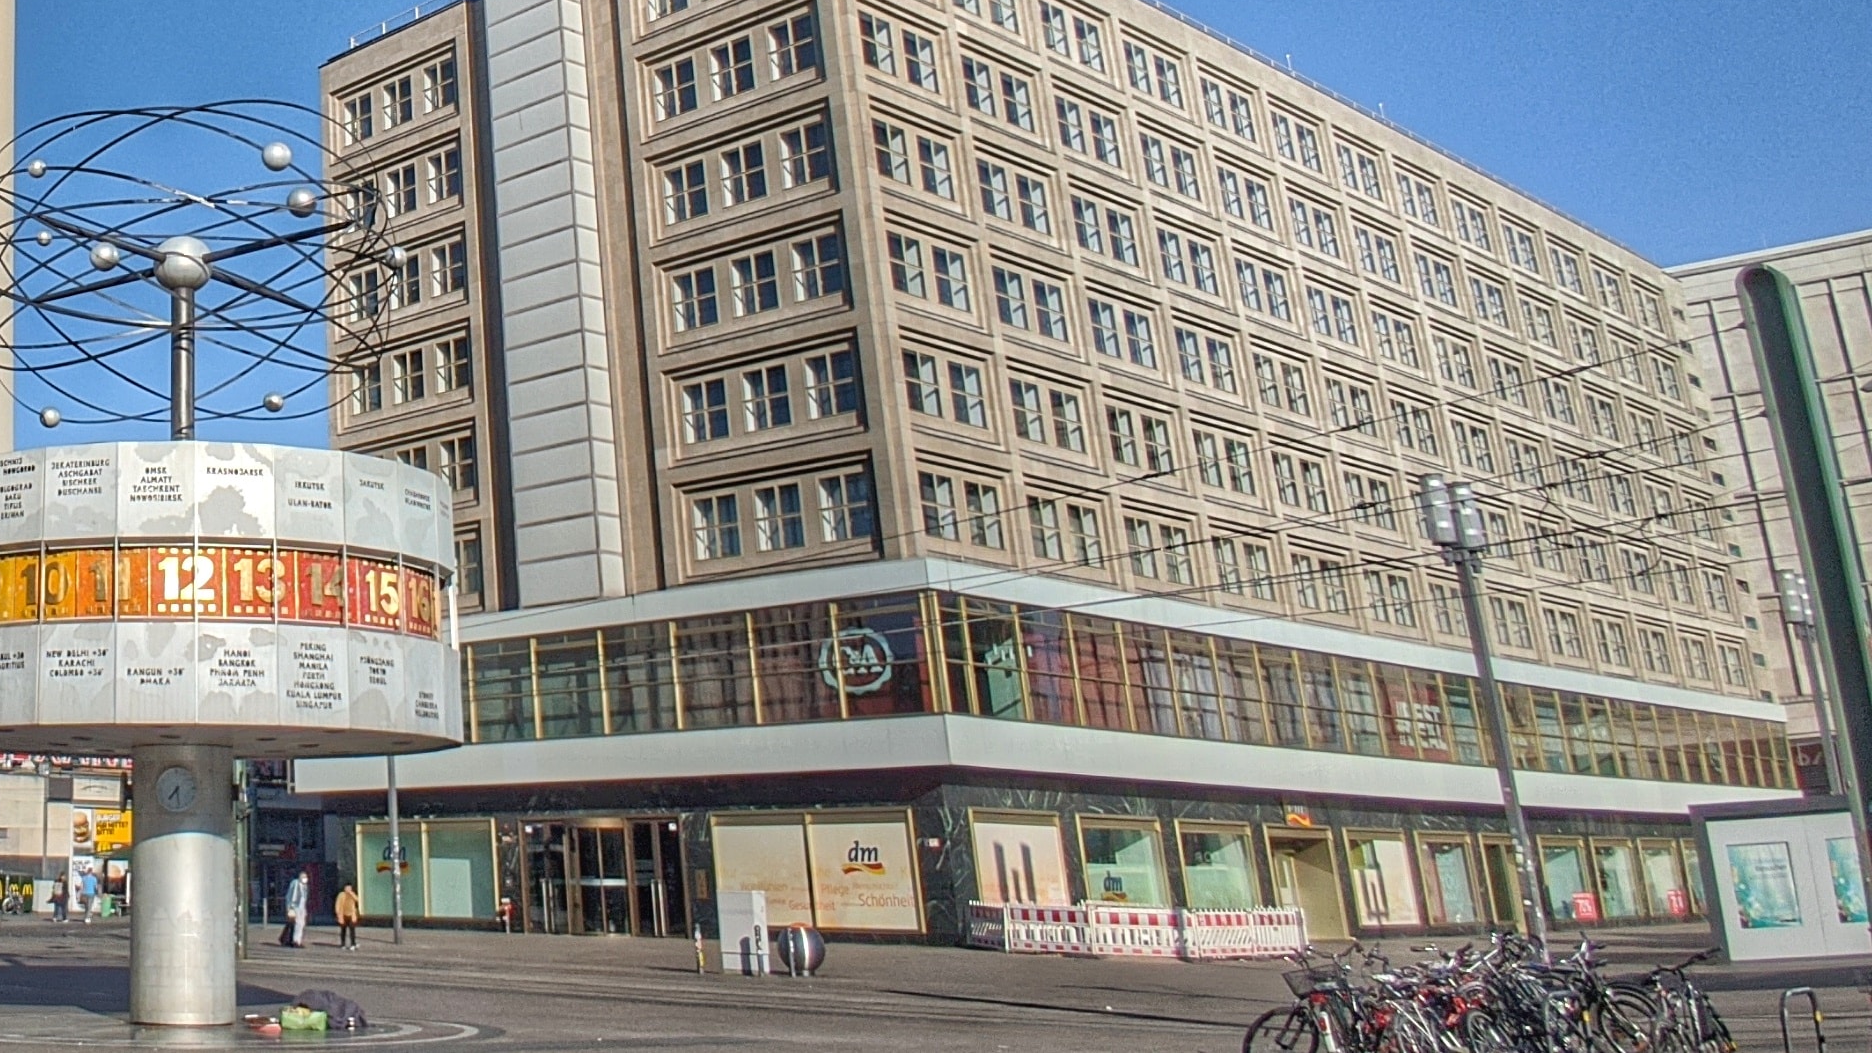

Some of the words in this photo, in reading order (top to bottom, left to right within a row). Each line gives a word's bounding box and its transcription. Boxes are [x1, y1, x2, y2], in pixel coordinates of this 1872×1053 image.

[51, 459, 110, 470] JEKATERINBURG
[57, 469, 103, 478] ASCHGABAT
[145, 467, 167, 475] OMSK
[206, 467, 264, 477] KRASNOJARSK
[62, 478, 97, 486] BISCHKEK
[140, 476, 173, 484] ALMATY
[359, 479, 385, 490] JAKUTSK
[133, 484, 180, 493] TASCHKENT
[295, 480, 325, 491] IRKUTSK
[57, 487, 103, 496] DUSCHANBE
[5, 494, 22, 502] BAKU
[129, 494, 183, 502] NOWOSIBIRSK
[288, 498, 332, 510] ULAN-BATOR
[89, 558, 132, 603] 11
[157, 556, 215, 602] 12
[234, 558, 286, 603] 13
[21, 563, 71, 606] 10
[305, 563, 344, 606] 14
[365, 570, 400, 614] 15
[408, 577, 430, 618] 16
[300, 642, 326, 652] PEKING
[46, 650, 62, 658] NEW
[67, 649, 89, 657] DELHI
[223, 650, 251, 658] HANOI
[293, 652, 333, 662] SHANGHAI
[58, 659, 95, 667] KARACHI
[218, 659, 256, 667] BANGKOK
[299, 662, 328, 671] MANILA
[49, 669, 84, 678] COLOMBO
[126, 668, 162, 676] RANGUN
[243, 669, 265, 677] PENH
[218, 679, 256, 687] JAKARTA
[286, 690, 310, 699] KUALA
[313, 691, 342, 700] LUMPUR
[296, 700, 333, 709] SINGAPUR
[848, 841, 878, 863] dm
[1104, 871, 1123, 892] dm
